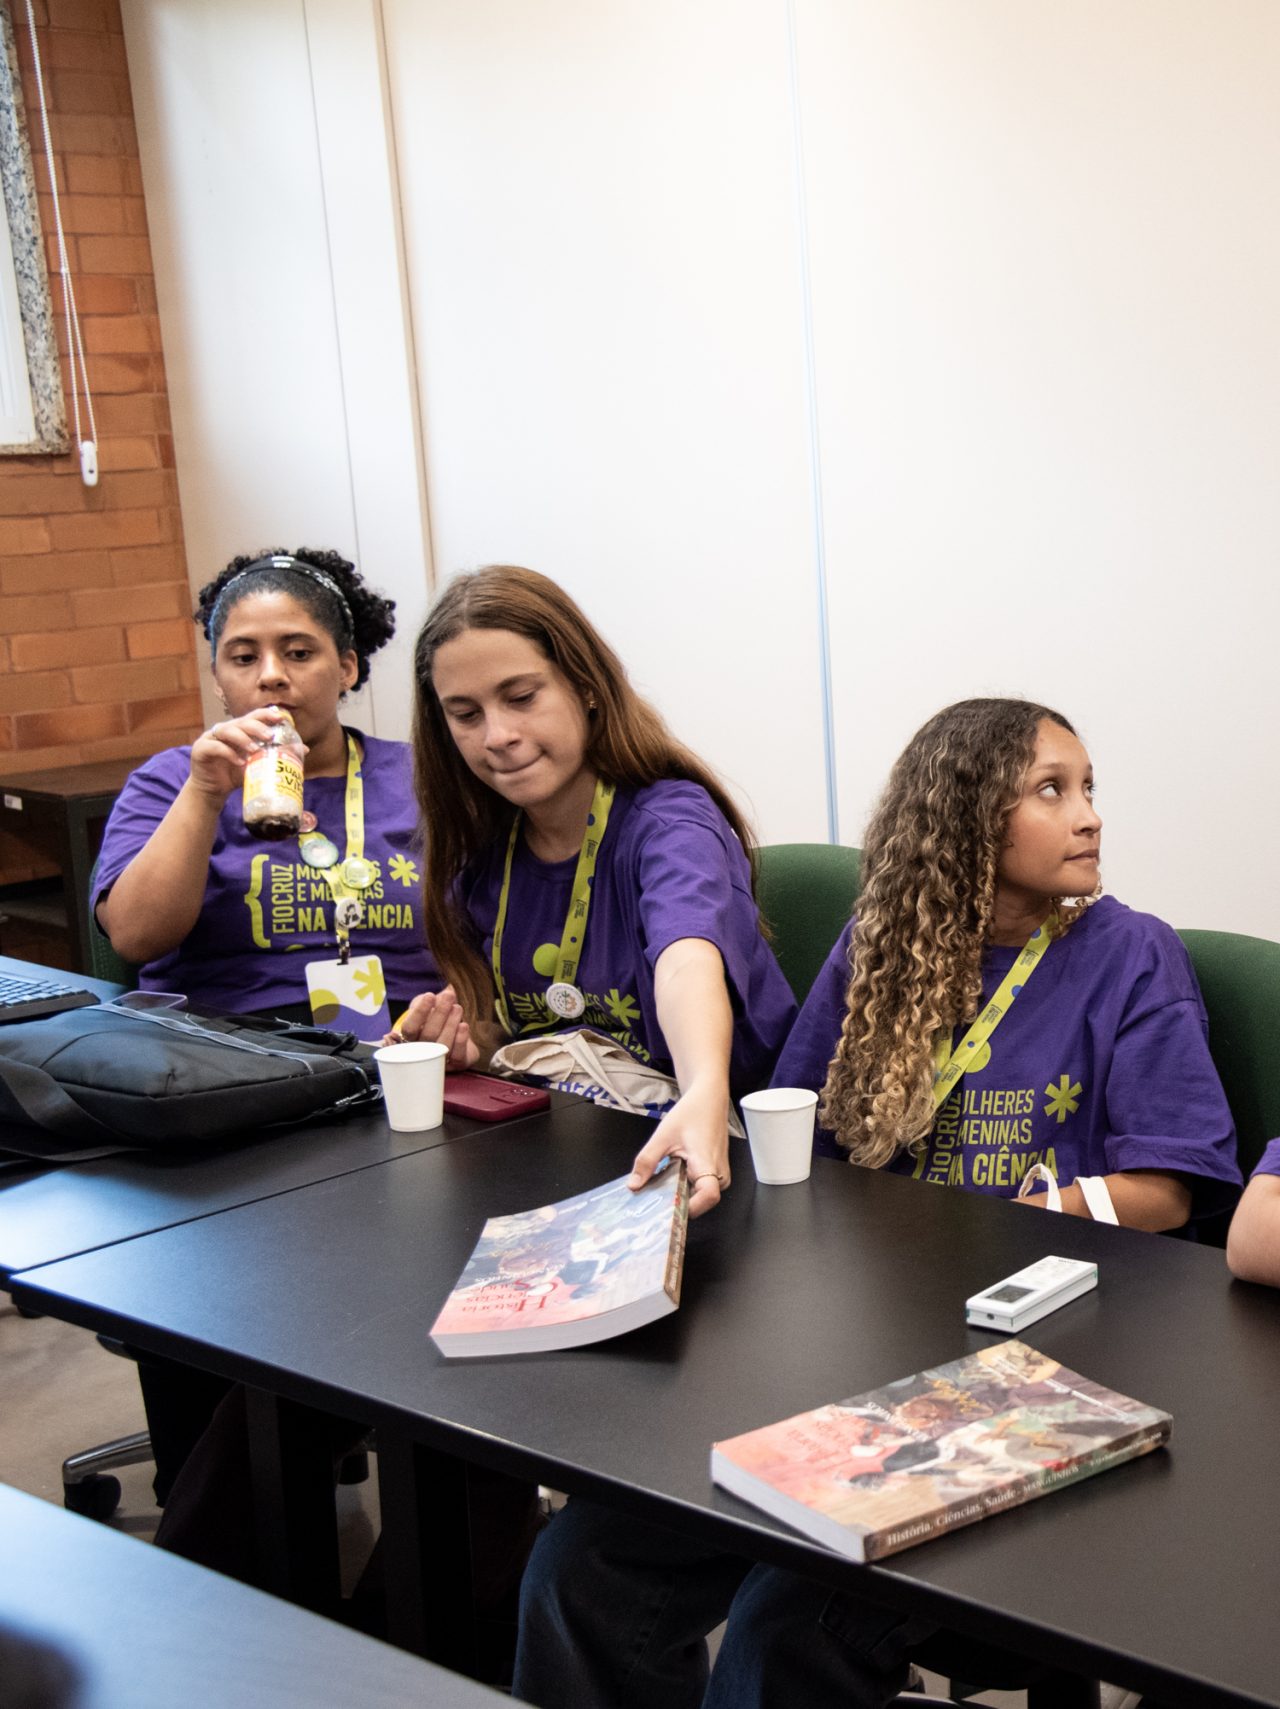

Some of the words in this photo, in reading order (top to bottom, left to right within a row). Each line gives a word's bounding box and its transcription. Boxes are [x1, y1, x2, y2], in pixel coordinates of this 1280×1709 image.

[271, 863, 295, 934] FIOCRUZ
[298, 906, 327, 932] NA
[962, 1088, 1035, 1116] ULHERES
